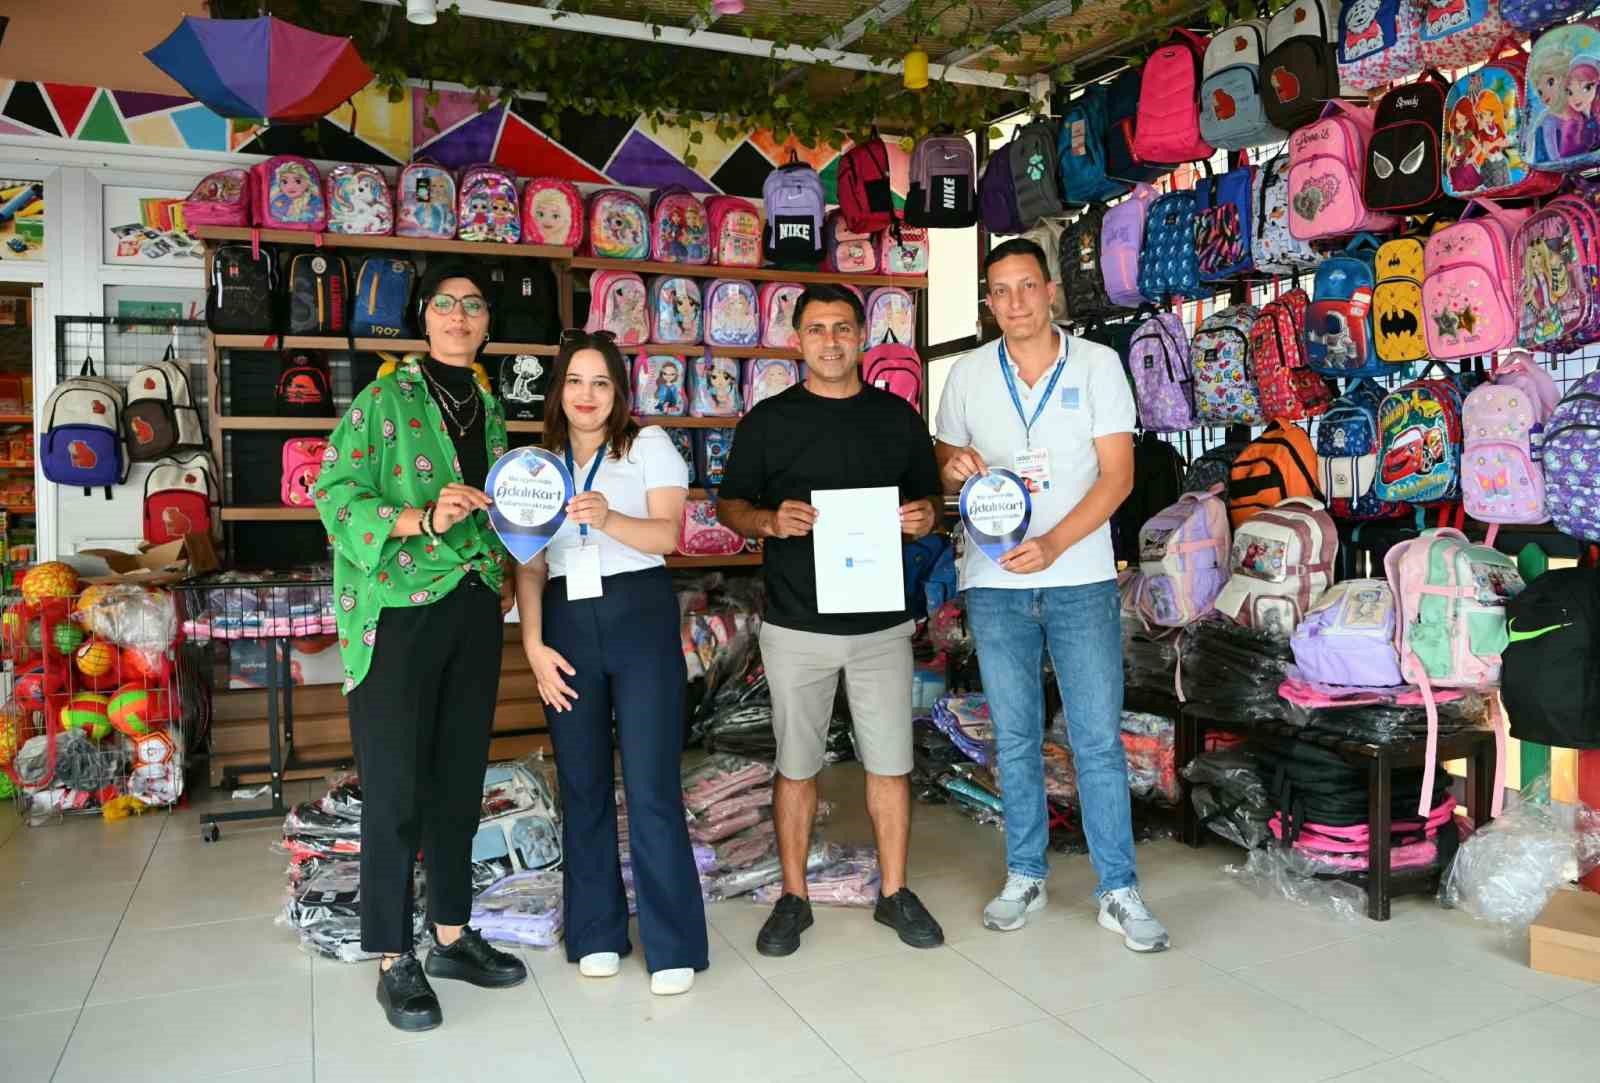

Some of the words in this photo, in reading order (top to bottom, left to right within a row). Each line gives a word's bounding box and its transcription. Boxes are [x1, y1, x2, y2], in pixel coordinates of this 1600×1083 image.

[943, 176, 955, 209] NIKE
[779, 223, 810, 241] NIKE
[370, 325, 401, 337] 1907
